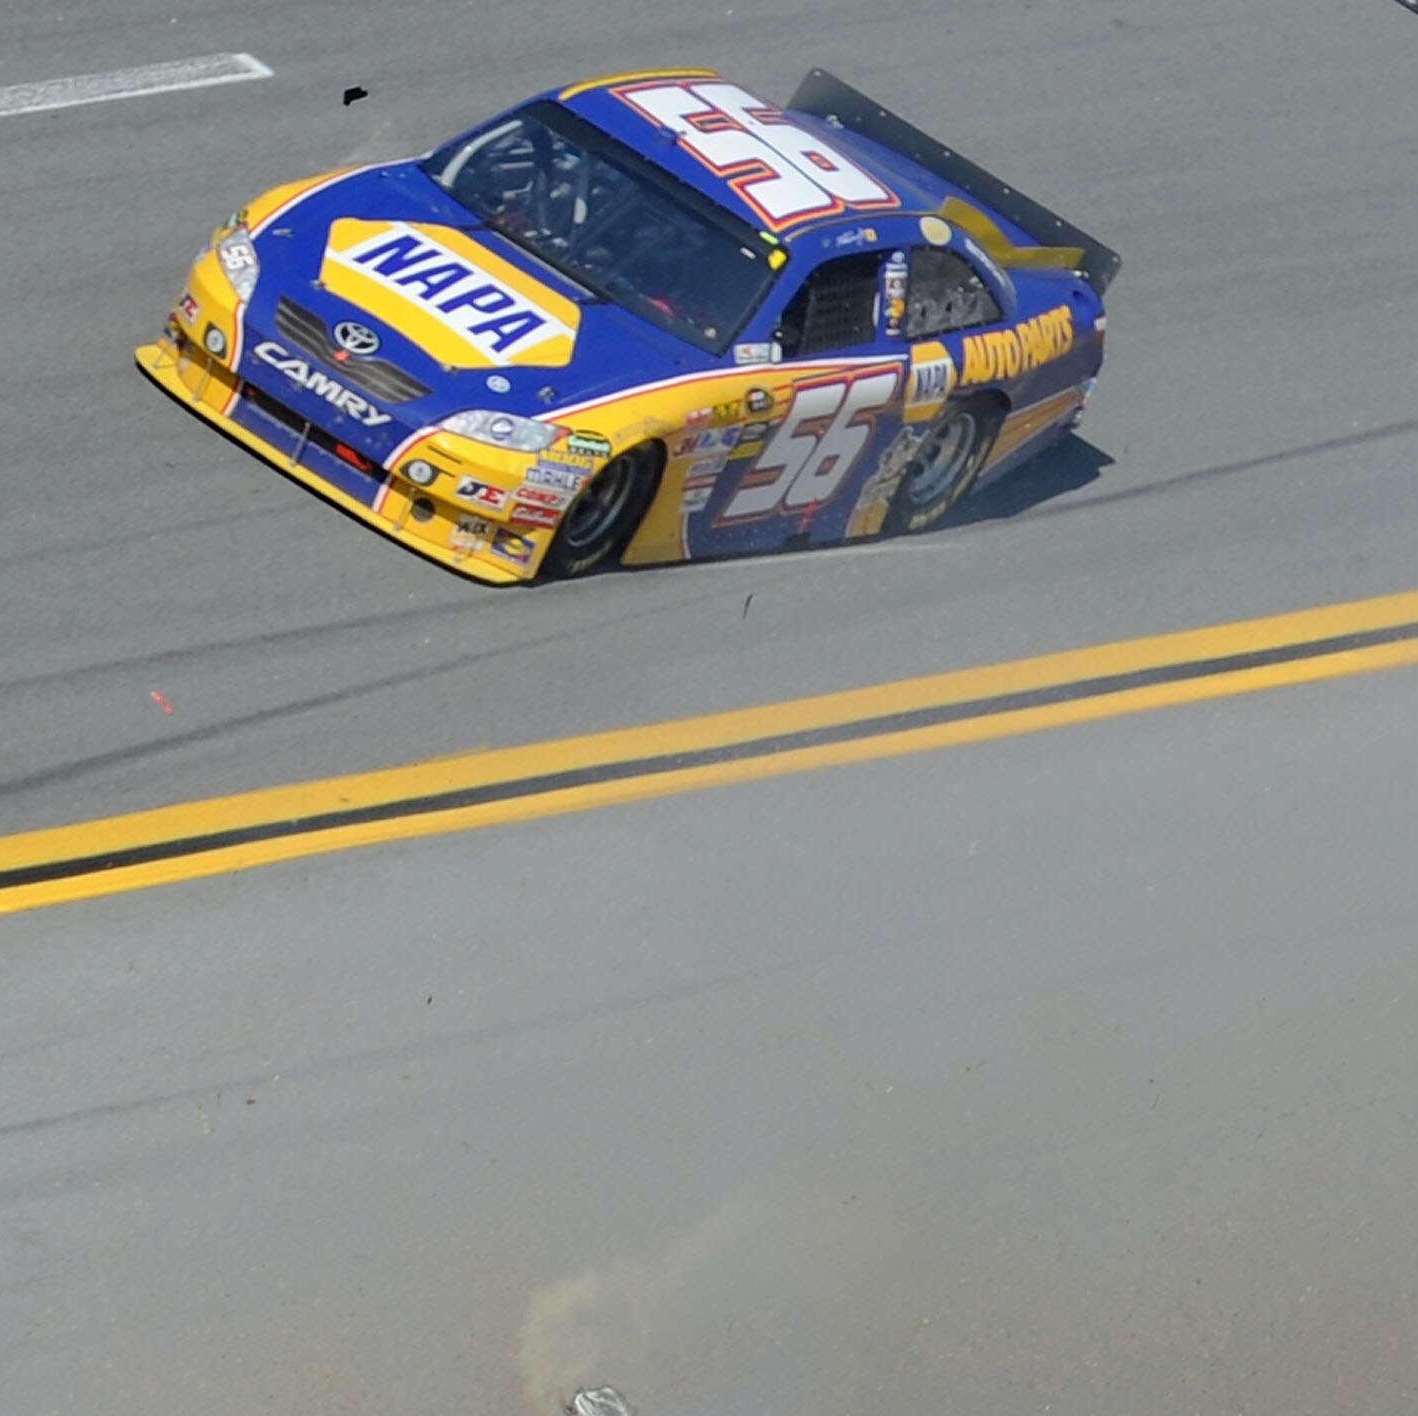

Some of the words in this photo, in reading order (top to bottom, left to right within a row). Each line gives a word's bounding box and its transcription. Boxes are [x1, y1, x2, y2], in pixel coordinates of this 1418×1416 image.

[614, 80, 900, 229] 56
[220, 244, 254, 270] 56
[353, 234, 548, 354] NAPA
[254, 341, 392, 426] CAMRY
[961, 330, 1021, 386] AUTO
[1016, 305, 1074, 371] PARTS
[714, 365, 903, 526] 56
[457, 481, 506, 505] JE
